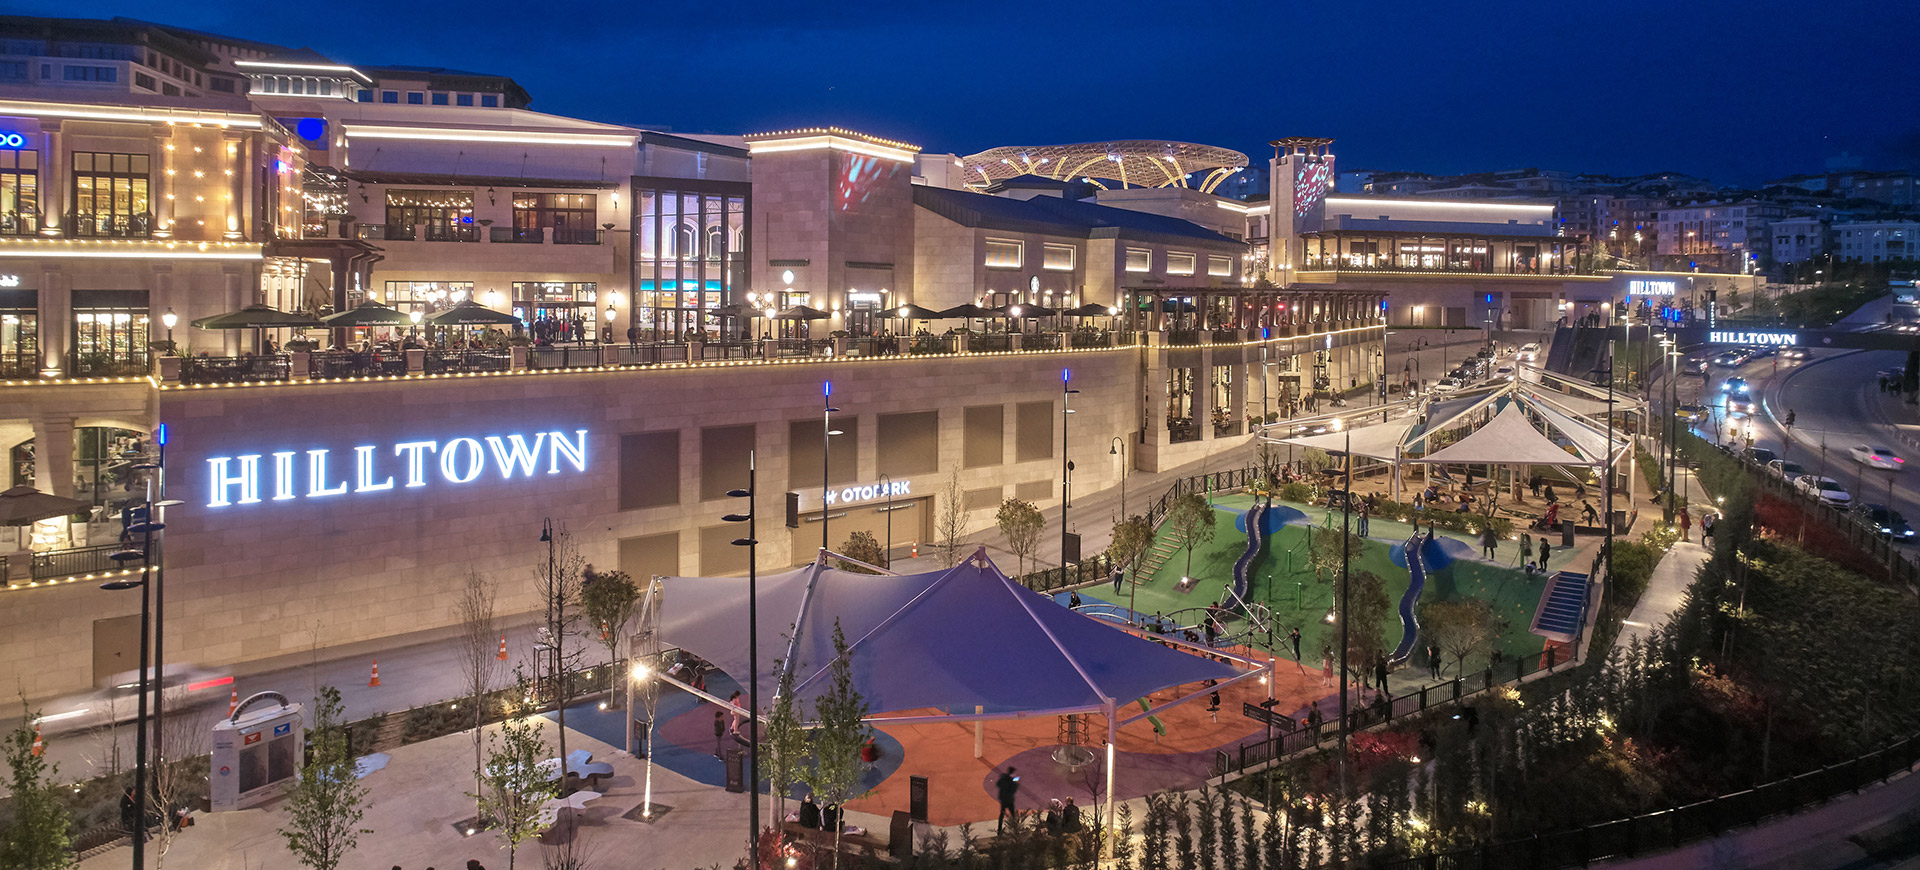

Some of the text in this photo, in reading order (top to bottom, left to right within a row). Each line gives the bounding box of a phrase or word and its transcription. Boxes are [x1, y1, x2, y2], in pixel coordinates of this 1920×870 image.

[1630, 280, 1676, 295] HILLTOWN
[1709, 331, 1797, 345] HILLTOWN
[206, 430, 589, 507] HILLTOWN
